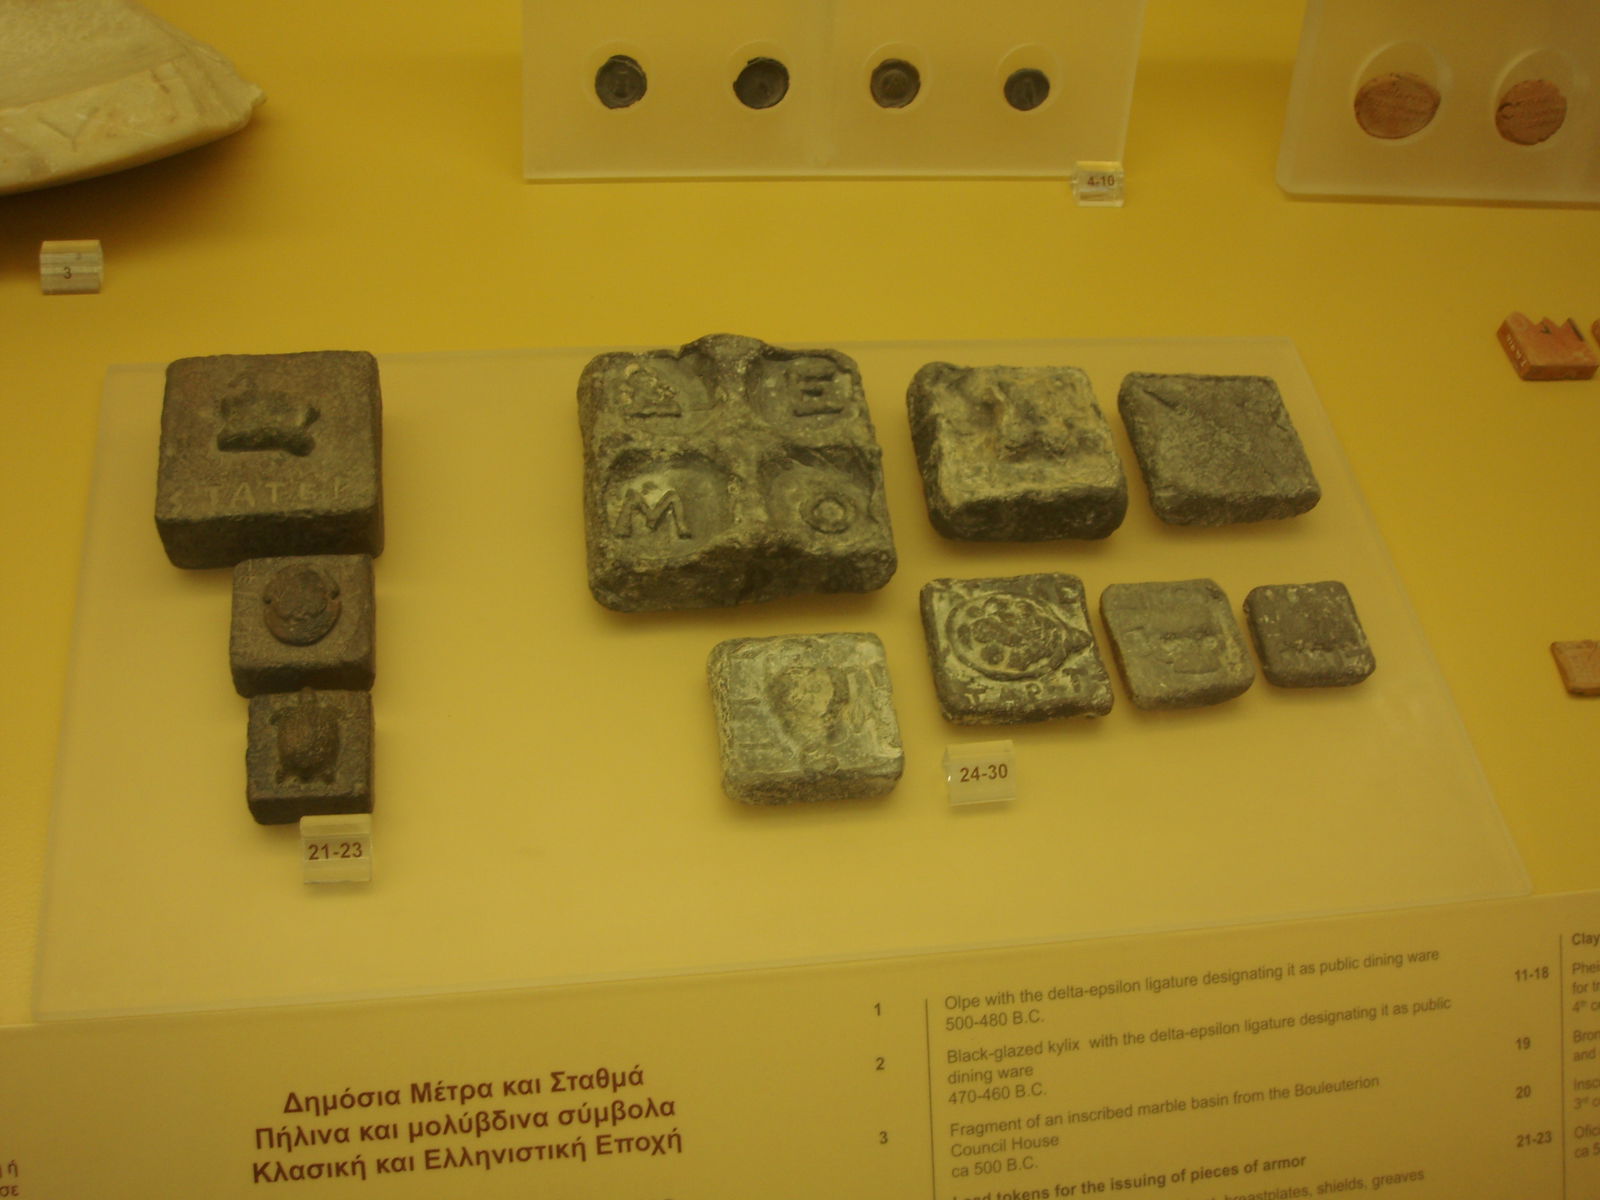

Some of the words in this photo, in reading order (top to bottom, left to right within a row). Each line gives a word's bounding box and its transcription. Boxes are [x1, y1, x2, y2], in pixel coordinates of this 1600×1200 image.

[1087, 174, 1115, 187] 4-10
[63, 266, 73, 280] 3
[959, 762, 1008, 784] 24-30
[307, 841, 363, 861] 21-23
[945, 994, 981, 1012] Olpe
[985, 990, 1016, 1007] with
[1020, 987, 1044, 1004] the
[1047, 978, 1142, 1001] delta-epsilon
[1145, 973, 1199, 995] ligature
[1203, 965, 1283, 986] designating
[1287, 962, 1297, 977] it
[1300, 963, 1316, 976] as
[1320, 955, 1361, 976] public
[1363, 952, 1404, 969] dining
[1407, 950, 1440, 964] ware
[1514, 966, 1550, 982] 11-18
[873, 1002, 882, 1017] 1
[946, 1012, 1008, 1032] 500-480
[1012, 1008, 1045, 1025] B.C.
[947, 1040, 1044, 1065] Black-glazed
[1048, 1037, 1081, 1055] kylix
[1089, 1032, 1119, 1049] with
[1123, 1029, 1146, 1046] the
[1149, 1021, 1241, 1043] delta-epsilon
[1244, 1015, 1296, 1035] ligature
[1300, 1005, 1378, 1026] designating
[1381, 1003, 1390, 1017] it
[1393, 1003, 1409, 1016] as
[1413, 995, 1453, 1016] public
[1515, 1036, 1531, 1051] 19
[875, 1056, 885, 1071] 2
[948, 1067, 993, 1085] dining
[997, 1064, 1034, 1081] ware
[282, 1087, 401, 1118] Δημόσια
[410, 1079, 494, 1107] Μέτρα
[502, 1076, 542, 1098] και
[550, 1064, 646, 1096] Σταθμά
[948, 1086, 1011, 1106] 470-460
[1015, 1082, 1048, 1099] B.C.
[1515, 1084, 1532, 1100] 20
[950, 1117, 1022, 1138] Fragment
[1026, 1113, 1042, 1129] of
[1045, 1114, 1064, 1127] an
[1068, 1103, 1133, 1125] inscribed
[1137, 1097, 1187, 1117] marble
[1191, 1093, 1230, 1111] basin
[1233, 1090, 1265, 1105] from
[1268, 1086, 1291, 1101] the
[1294, 1076, 1380, 1098] Bouleuterion
[255, 1122, 350, 1152] Πήλινα
[359, 1121, 399, 1143] και
[408, 1109, 550, 1144] μολύβδινα
[558, 1097, 677, 1128] σύμβολα
[879, 1130, 889, 1145] 3
[952, 1138, 1007, 1158] Council
[1011, 1133, 1060, 1151] House
[1516, 1130, 1553, 1148] 21-23
[252, 1153, 367, 1185] Κλασική
[375, 1152, 416, 1175] και
[424, 1135, 588, 1172] Ελληνιστική
[595, 1127, 684, 1157] Εποχή
[951, 1166, 969, 1178] ca
[974, 1160, 1003, 1176] 500
[1007, 1155, 1040, 1172] B.C.
[1054, 1183, 1078, 1198] for
[1081, 1177, 1106, 1195] the
[1110, 1170, 1167, 1190] issuing
[1171, 1167, 1187, 1183] of
[1190, 1165, 1240, 1184] pieces
[1243, 1159, 1259, 1174] of
[1263, 1155, 1307, 1172] armor
[1316, 1175, 1368, 1196] shields,
[1371, 1168, 1426, 1190] greaves
